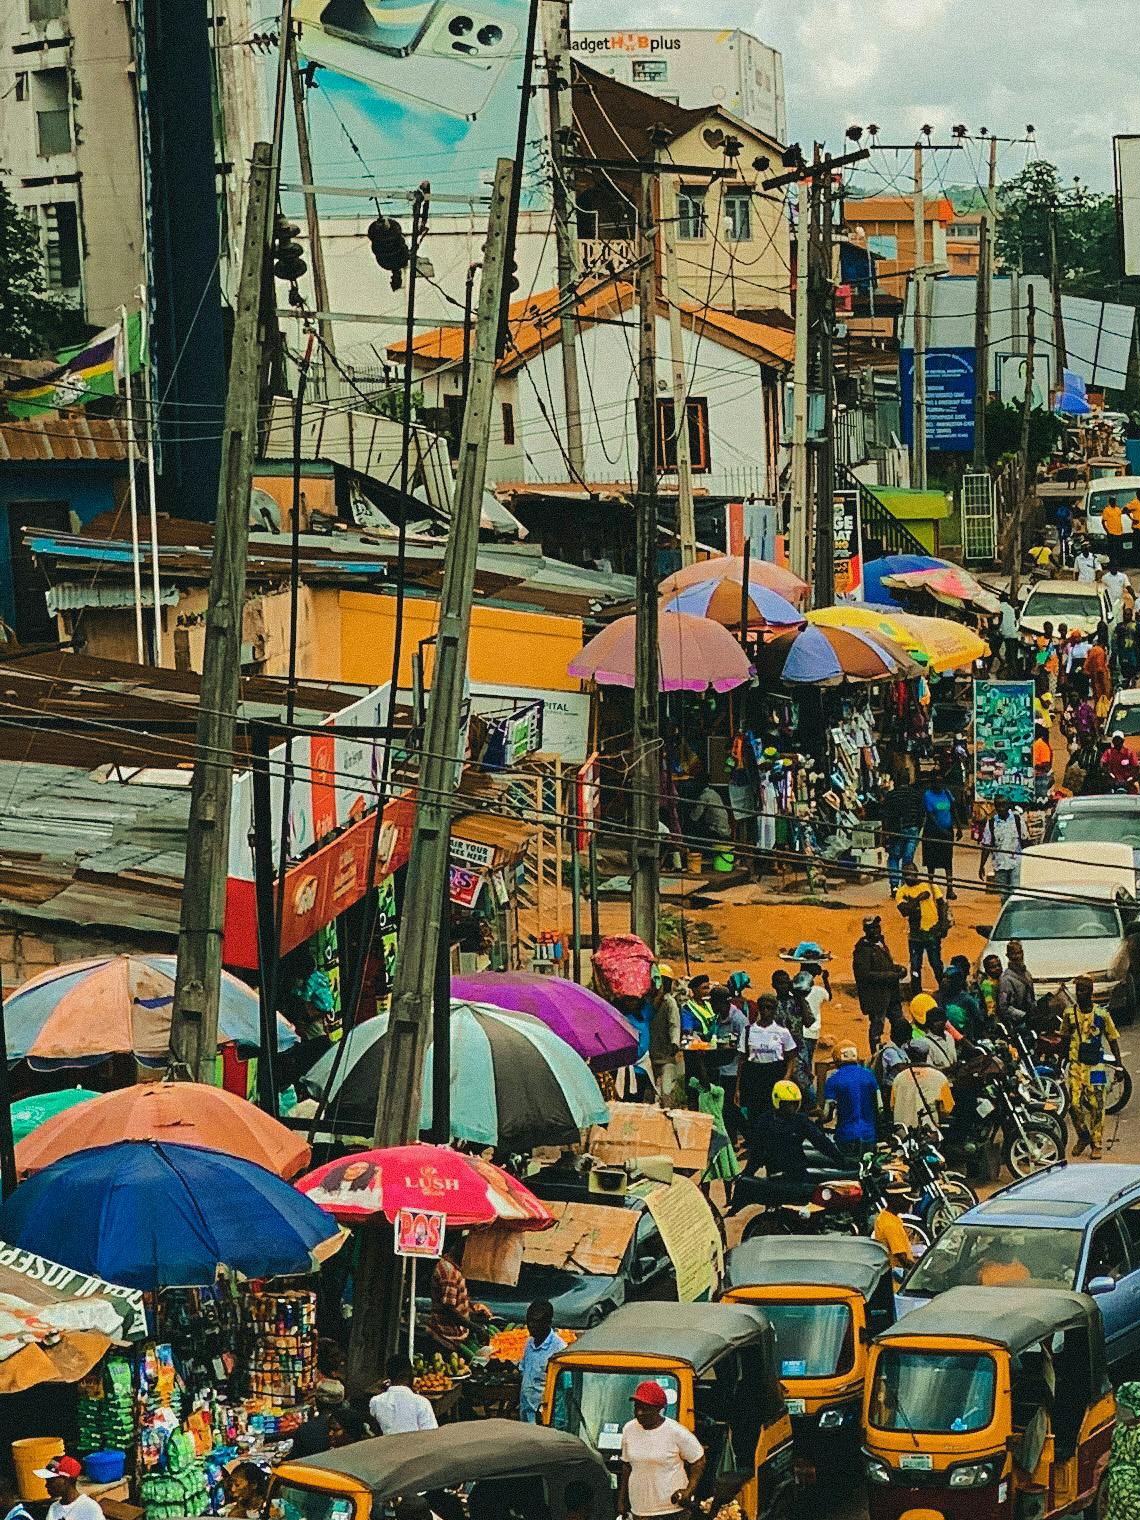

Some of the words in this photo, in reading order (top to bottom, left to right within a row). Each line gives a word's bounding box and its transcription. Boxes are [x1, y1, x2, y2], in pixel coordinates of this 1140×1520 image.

[571, 33, 681, 53] adgetHBplus
[404, 1175, 460, 1191] LUSH
[400, 1211, 441, 1248] POS
